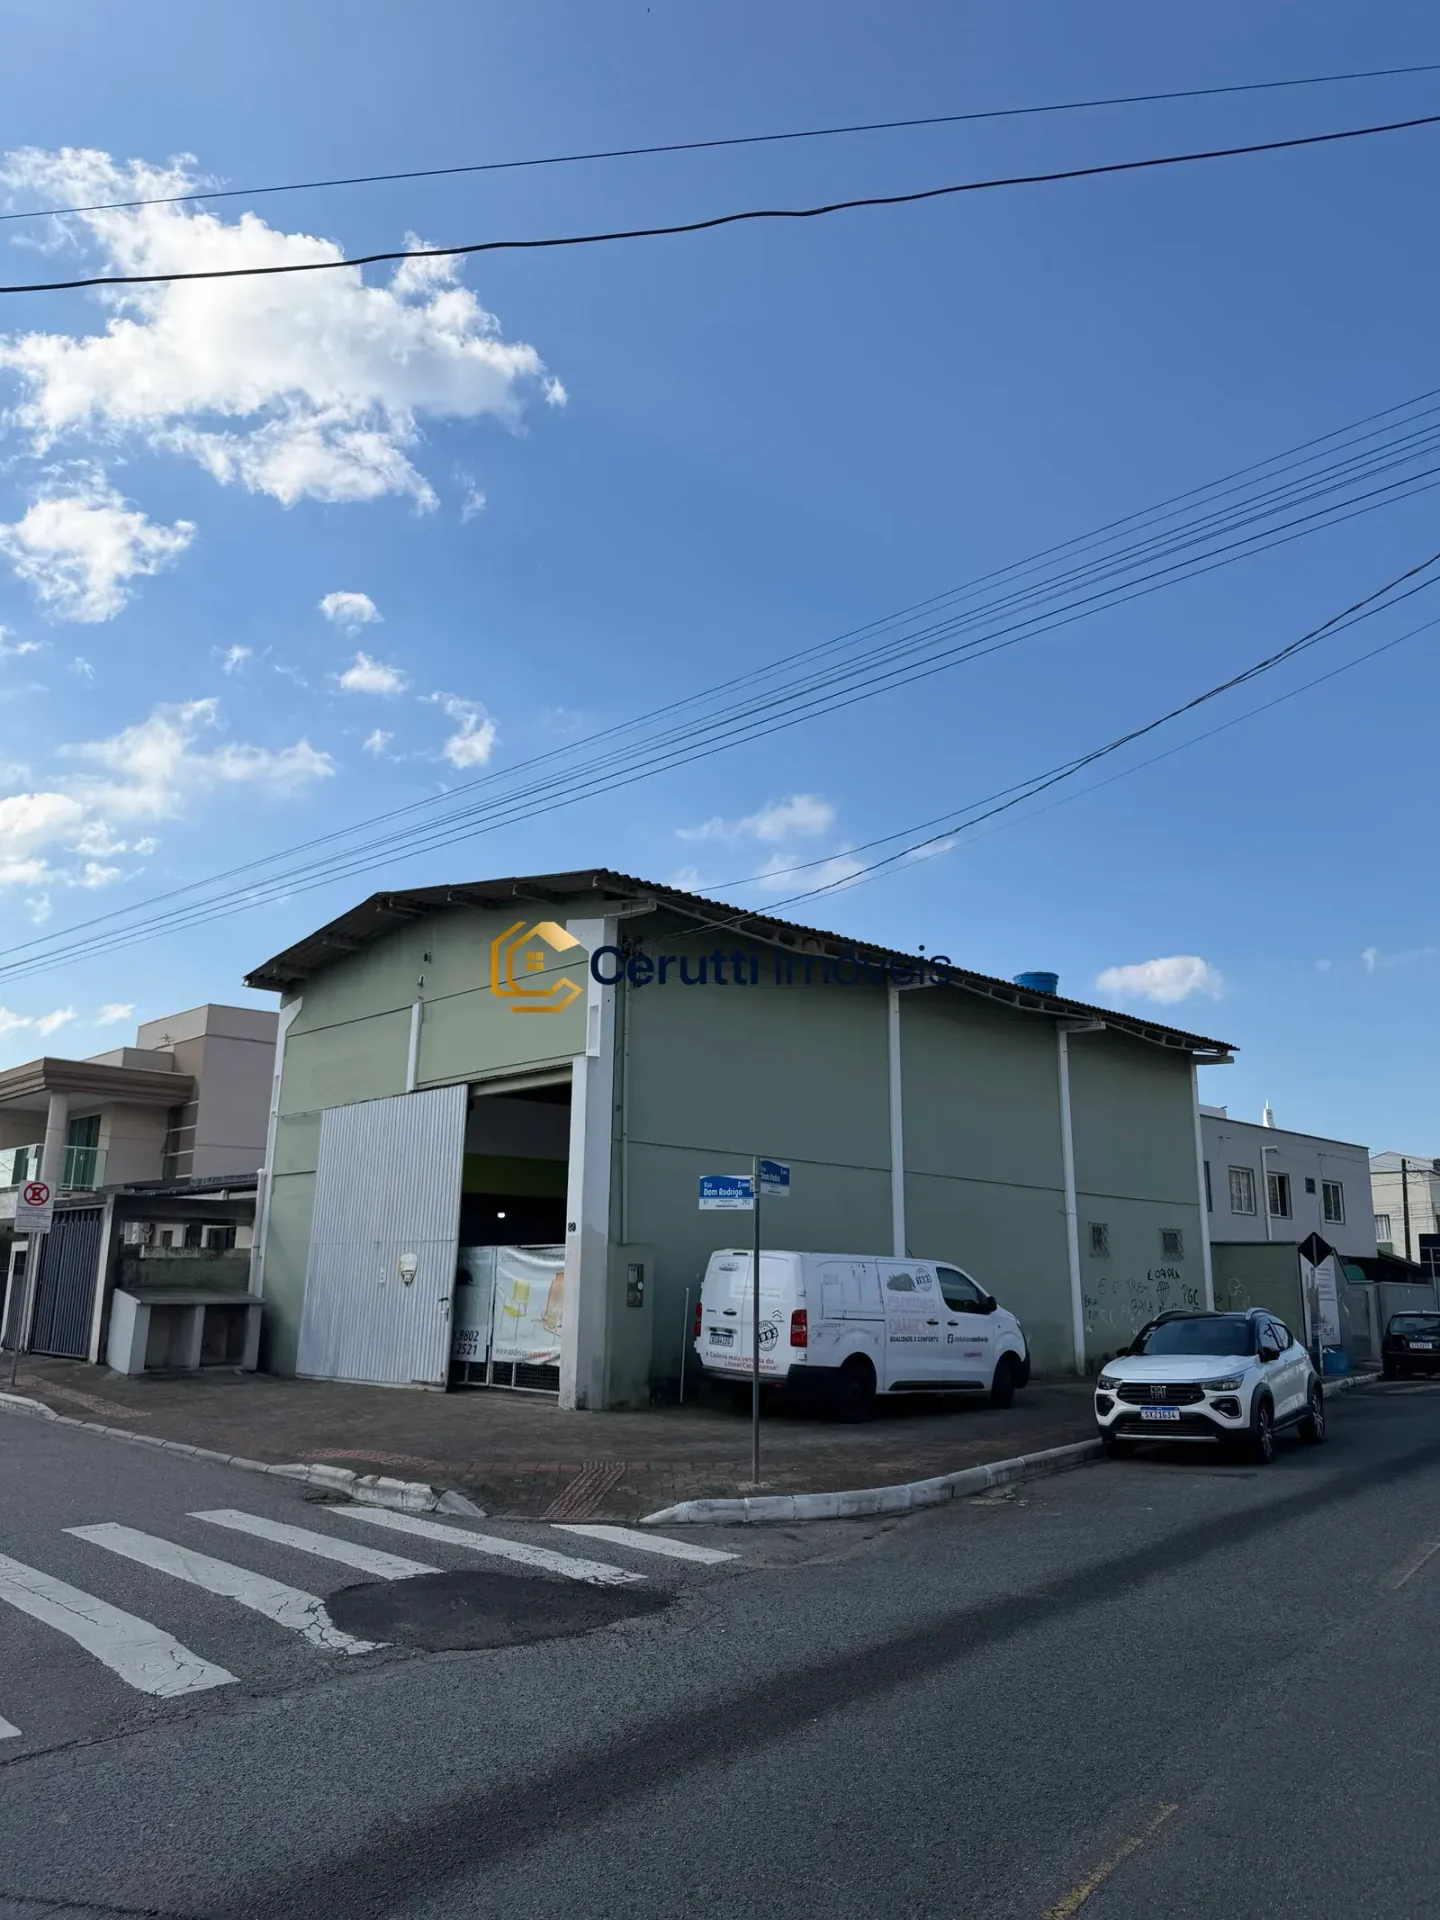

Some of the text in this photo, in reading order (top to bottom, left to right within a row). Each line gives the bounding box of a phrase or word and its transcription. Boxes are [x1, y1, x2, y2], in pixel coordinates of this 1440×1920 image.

[703, 1187, 743, 1198] Dom Rodrigo
[567, 1221, 576, 1232] 89
[758, 1329, 778, 1342] 993
[1149, 1385, 1167, 1399] FIAT
